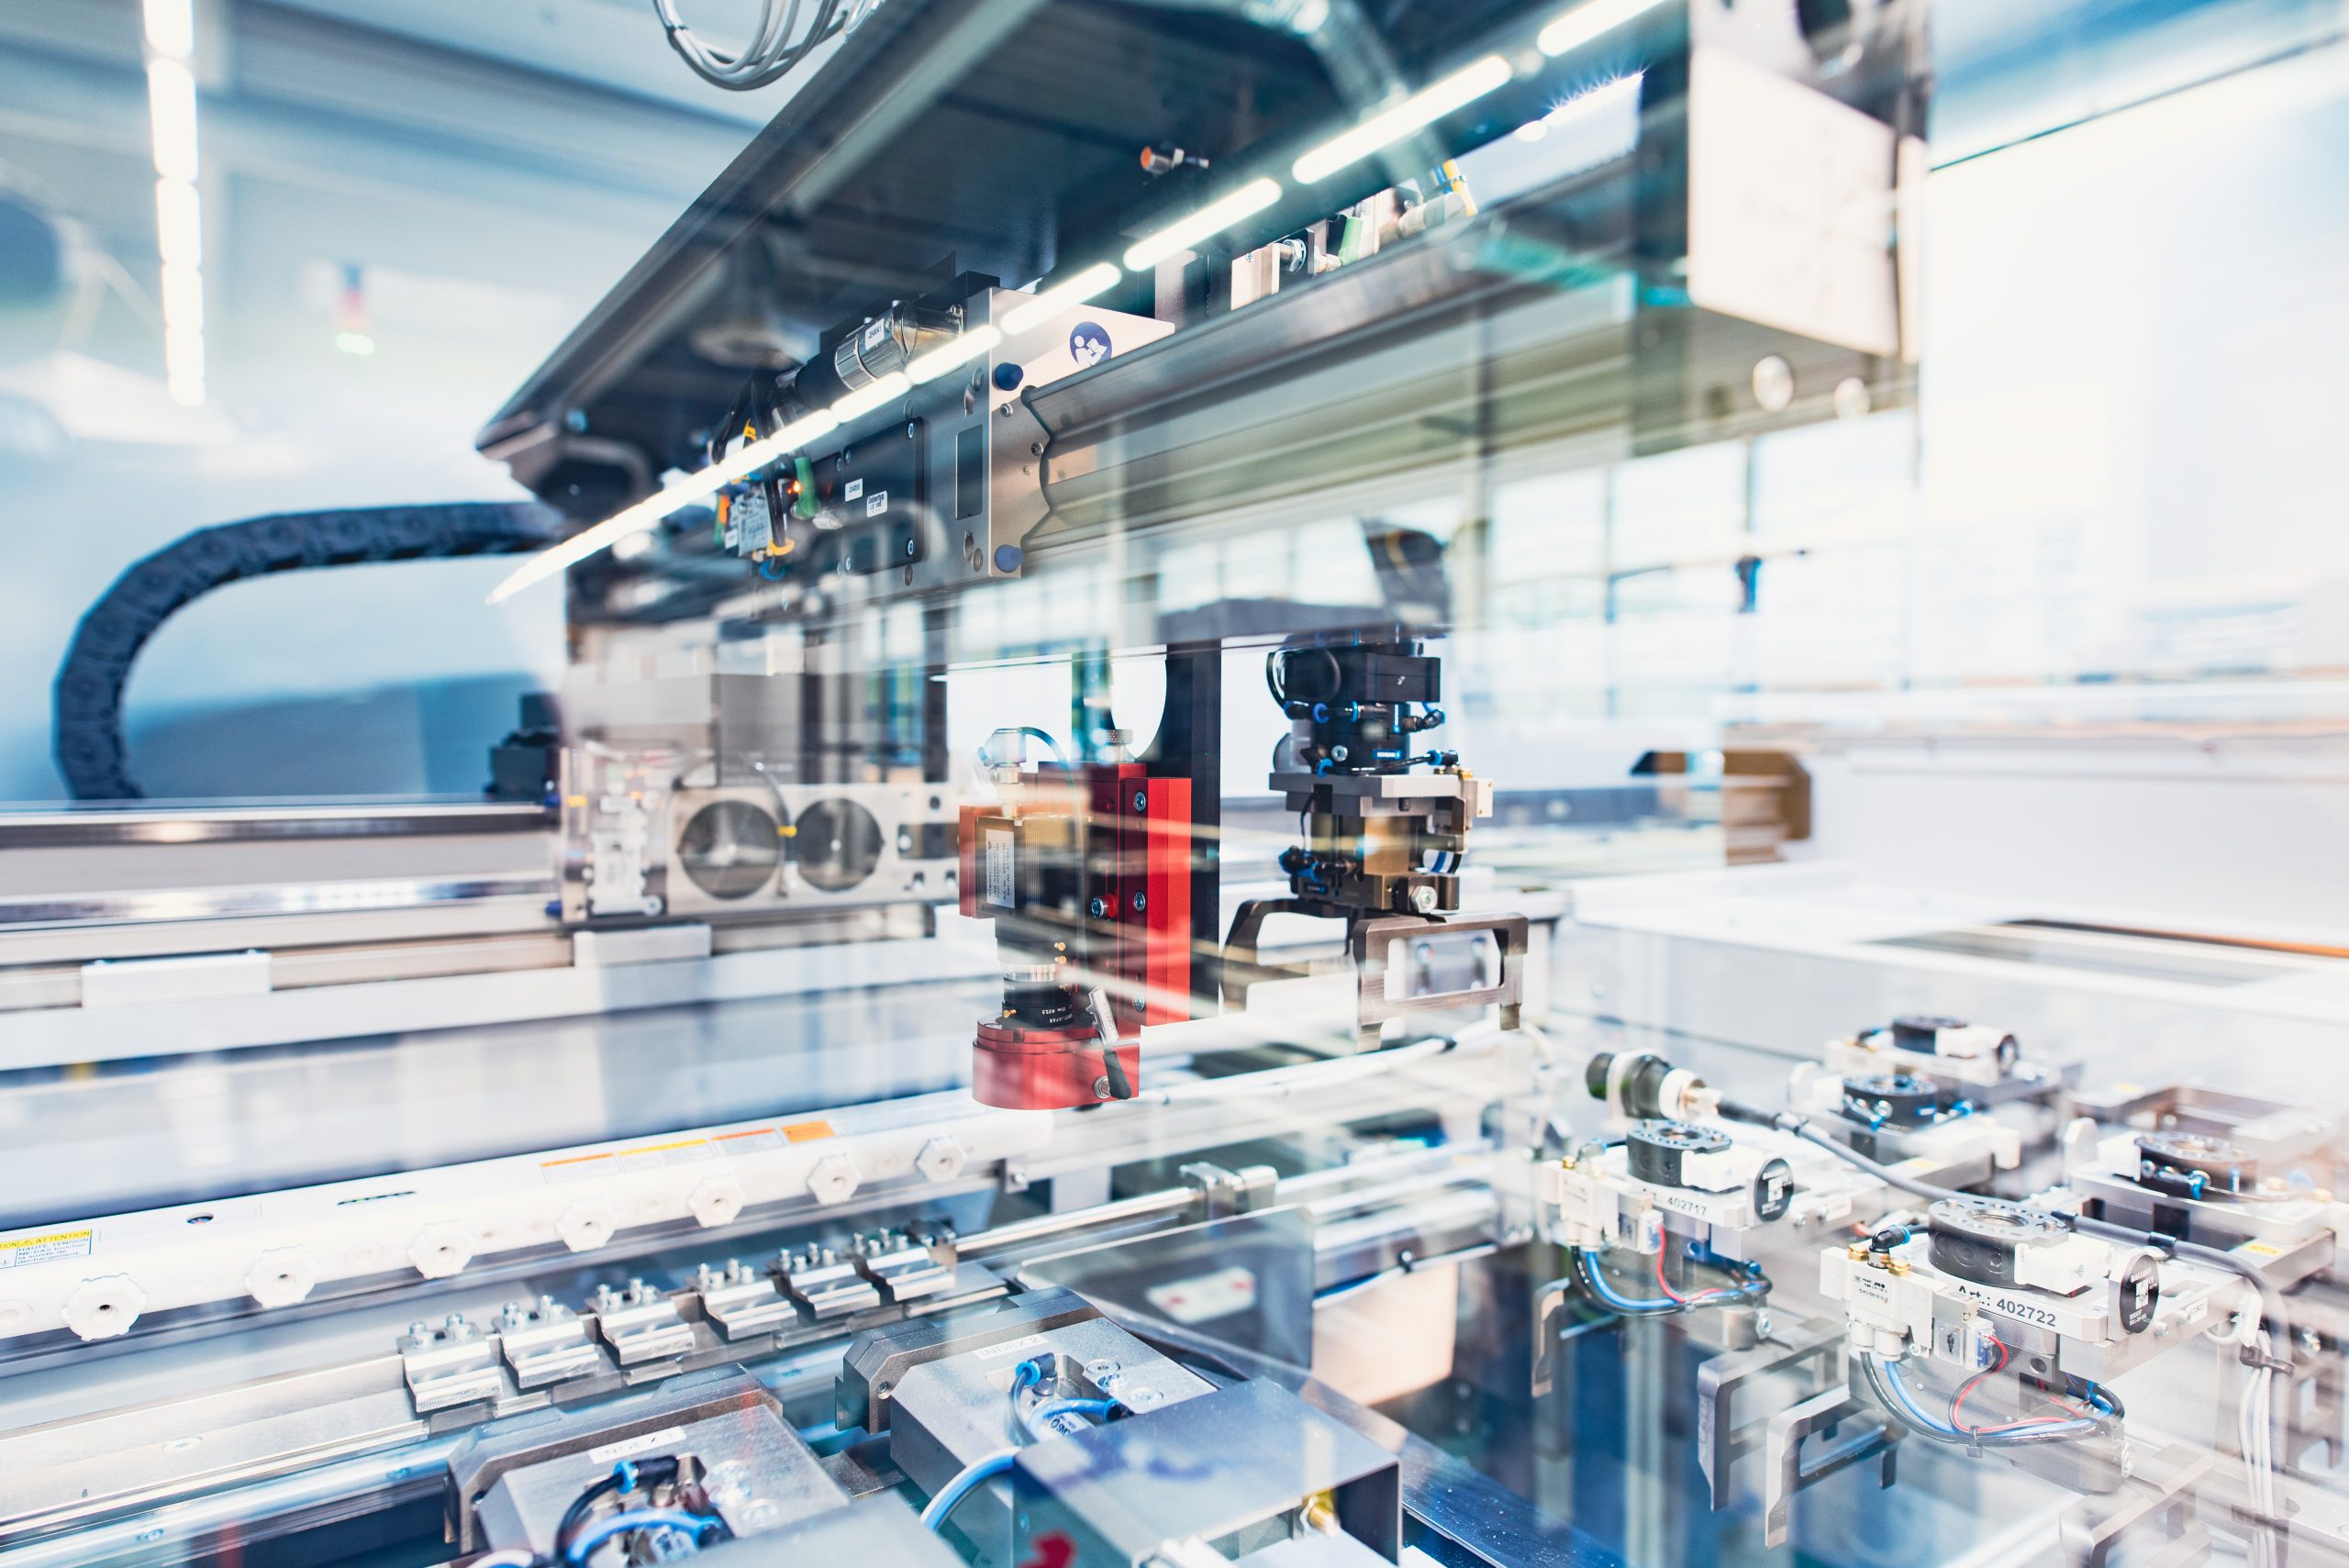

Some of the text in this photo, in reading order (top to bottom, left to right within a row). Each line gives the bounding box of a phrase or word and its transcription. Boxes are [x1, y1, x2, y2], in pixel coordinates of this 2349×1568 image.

[1667, 1196, 1708, 1217] 402717
[36, 1231, 90, 1244] ATTENTION
[1996, 1298, 2057, 1328] 402722
[979, 1340, 1024, 1357] INDEX
